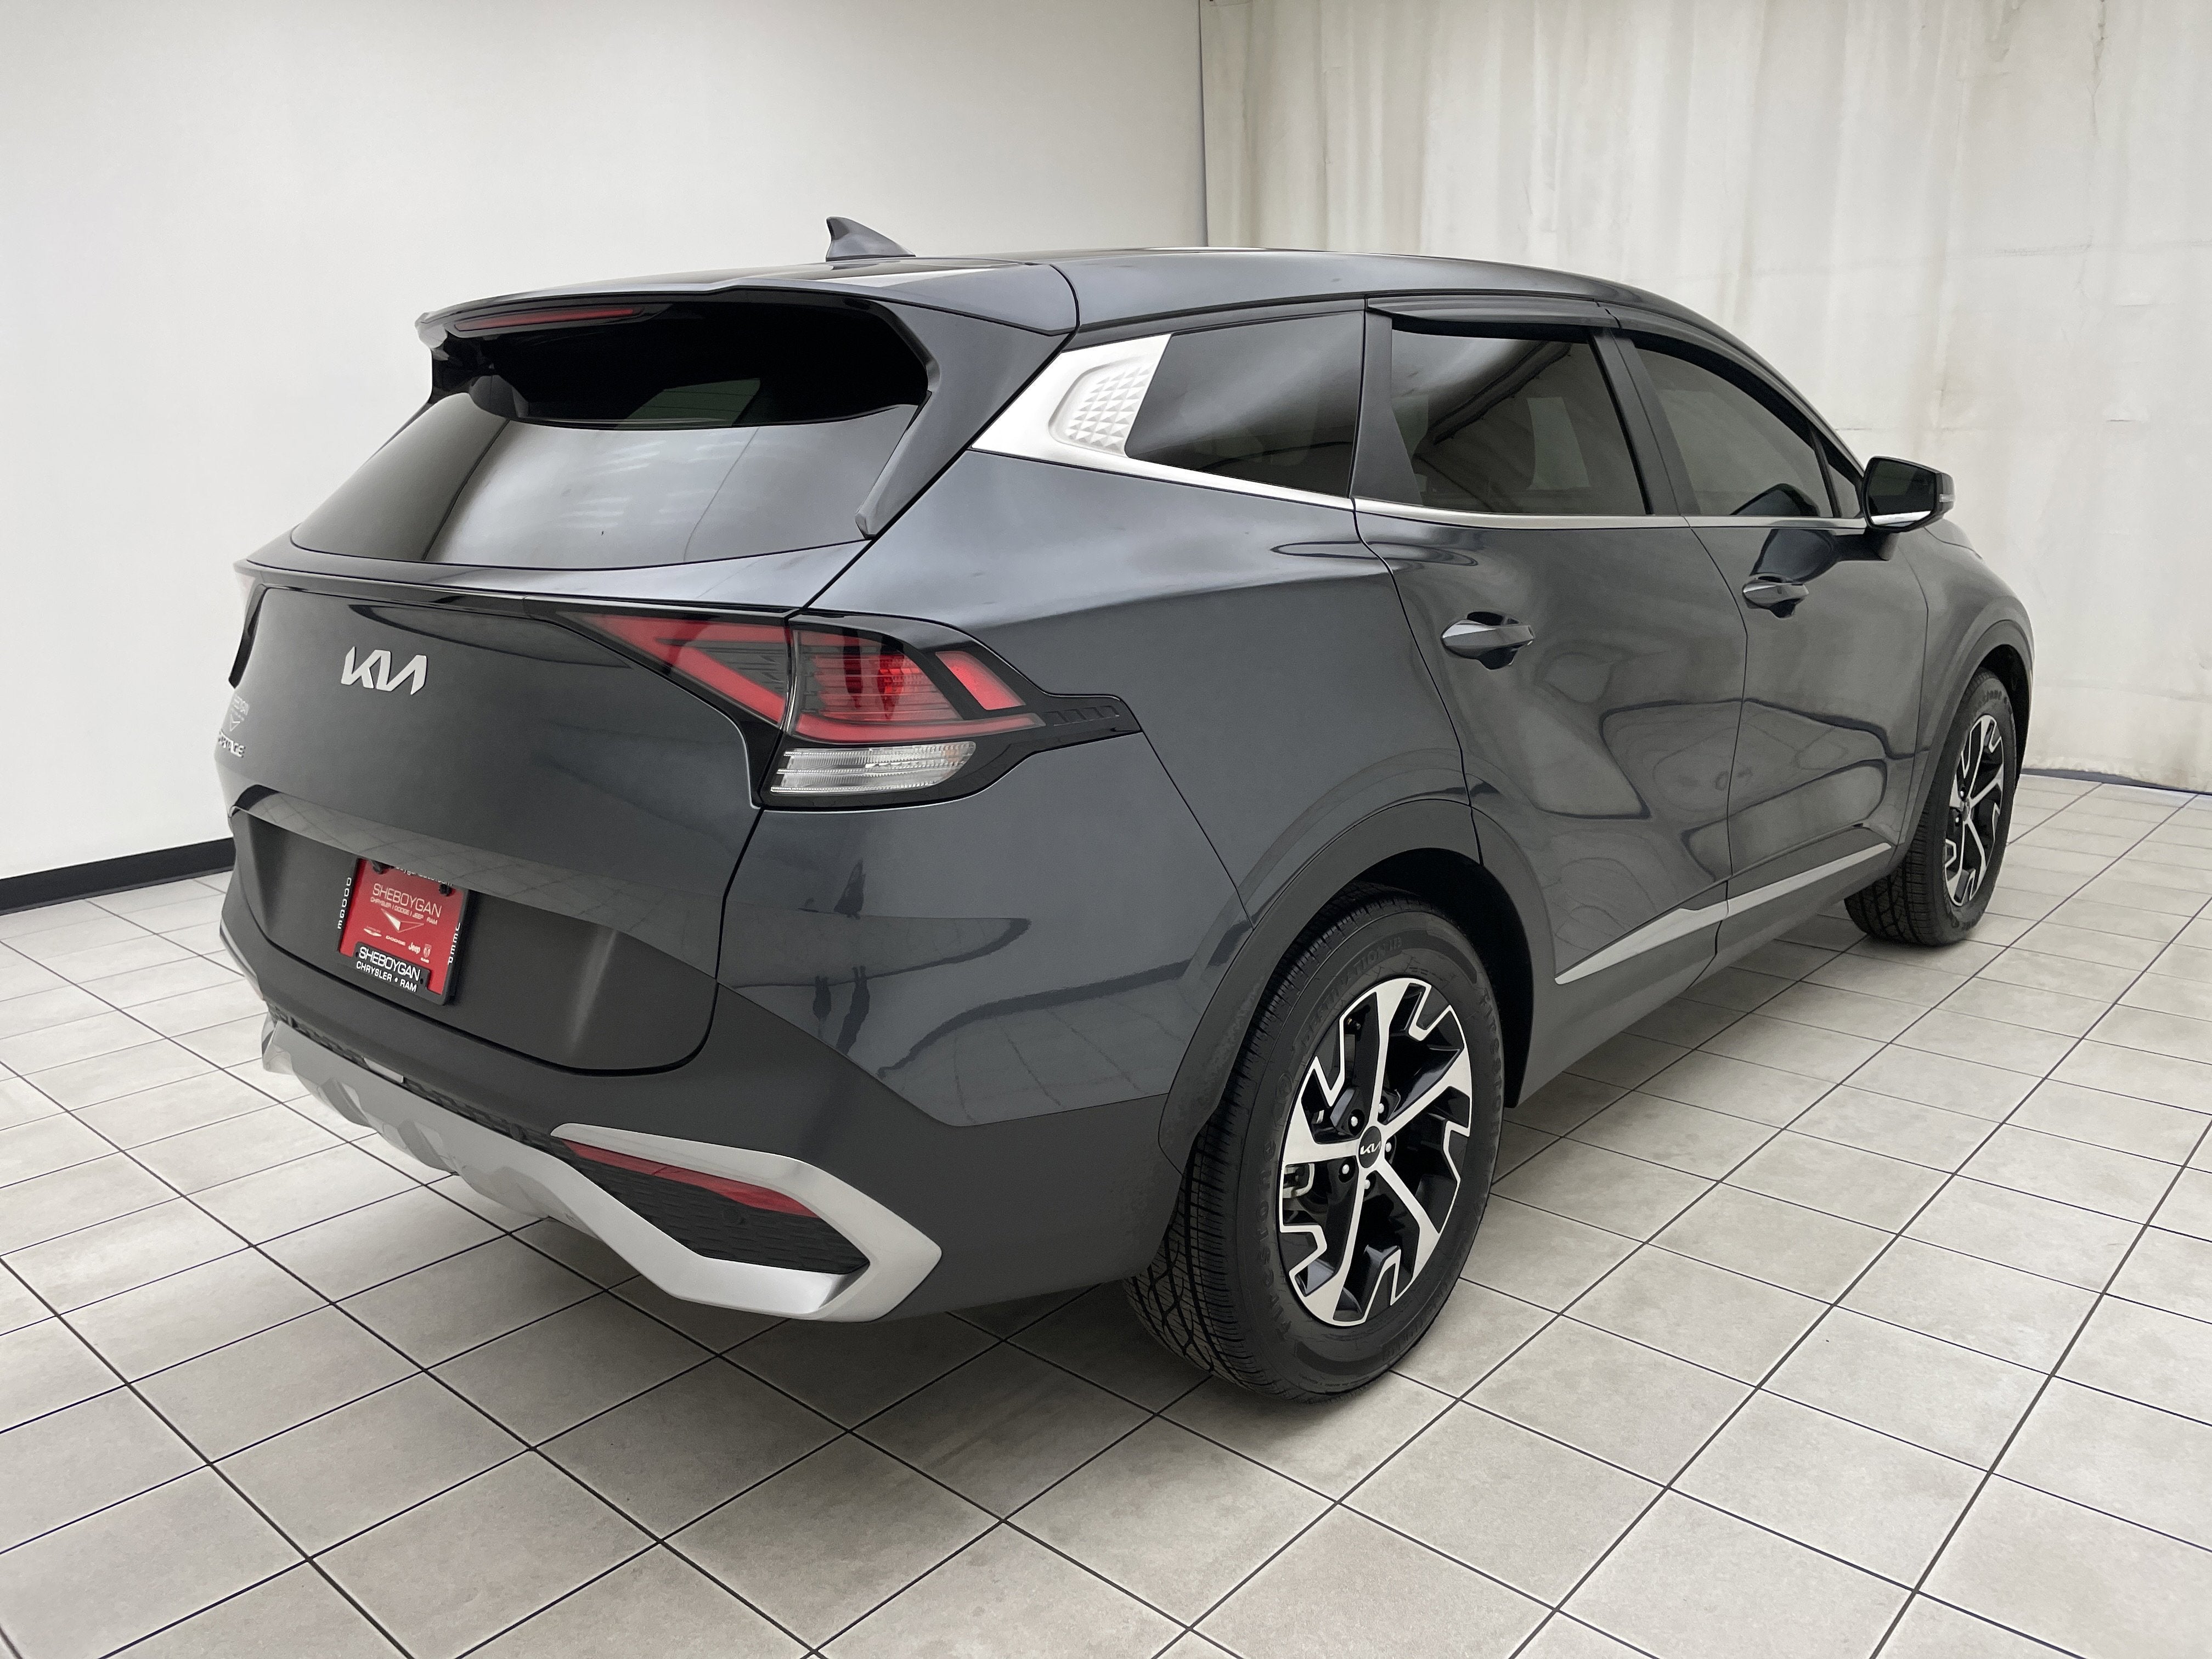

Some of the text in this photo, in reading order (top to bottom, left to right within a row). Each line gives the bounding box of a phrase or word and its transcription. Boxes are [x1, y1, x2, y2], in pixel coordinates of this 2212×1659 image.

[341, 646, 427, 696] KIA
[337, 877, 352, 929] DODGE
[370, 896, 392, 909] CHRYSLER
[426, 917, 438, 926] RAM
[373, 883, 442, 918] SHEBOYGAN
[408, 942, 421, 954] Jeep
[448, 922, 461, 965] JEEP
[356, 961, 417, 992] CHRYSLER RAM
[359, 946, 421, 981] SHEBOYGAN
